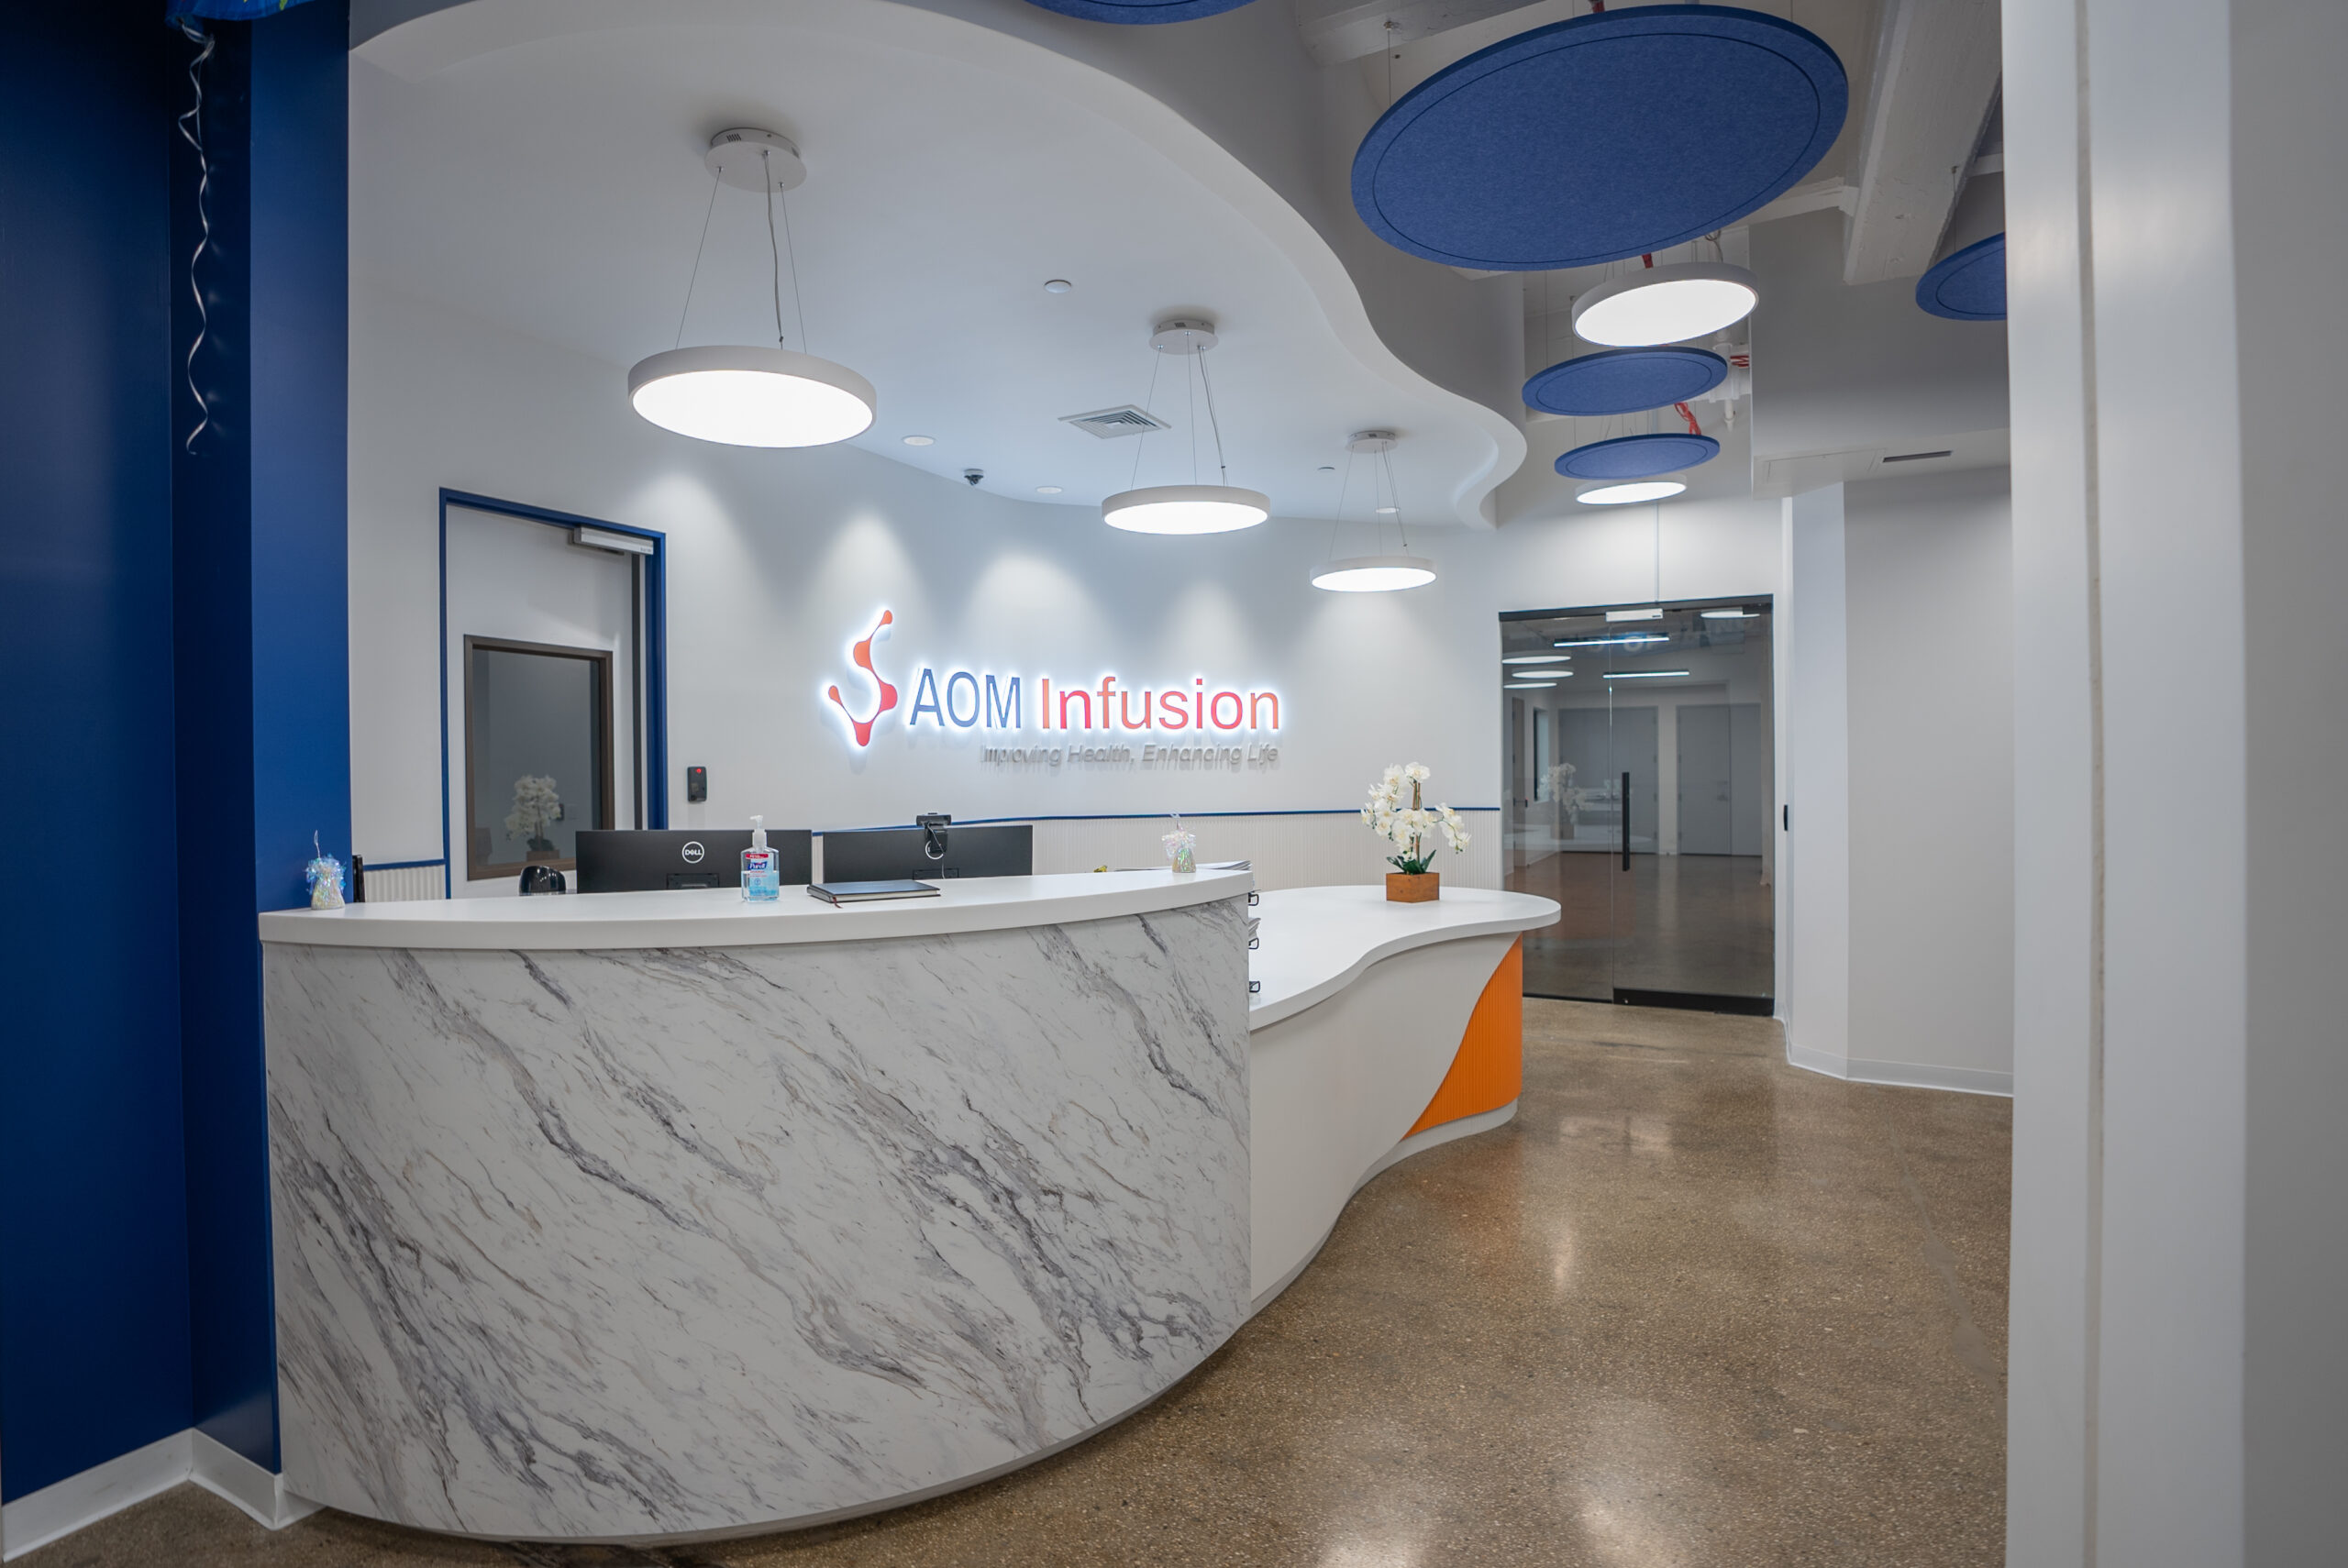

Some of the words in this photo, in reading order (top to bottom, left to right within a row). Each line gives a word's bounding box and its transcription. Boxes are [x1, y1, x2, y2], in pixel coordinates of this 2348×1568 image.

[909, 668, 1021, 728] AOM
[1041, 676, 1279, 729] Infusion
[980, 745, 1062, 767] Improving
[1067, 744, 1135, 765] Health,
[1142, 743, 1243, 765] Enhancing
[1246, 743, 1279, 766] Life
